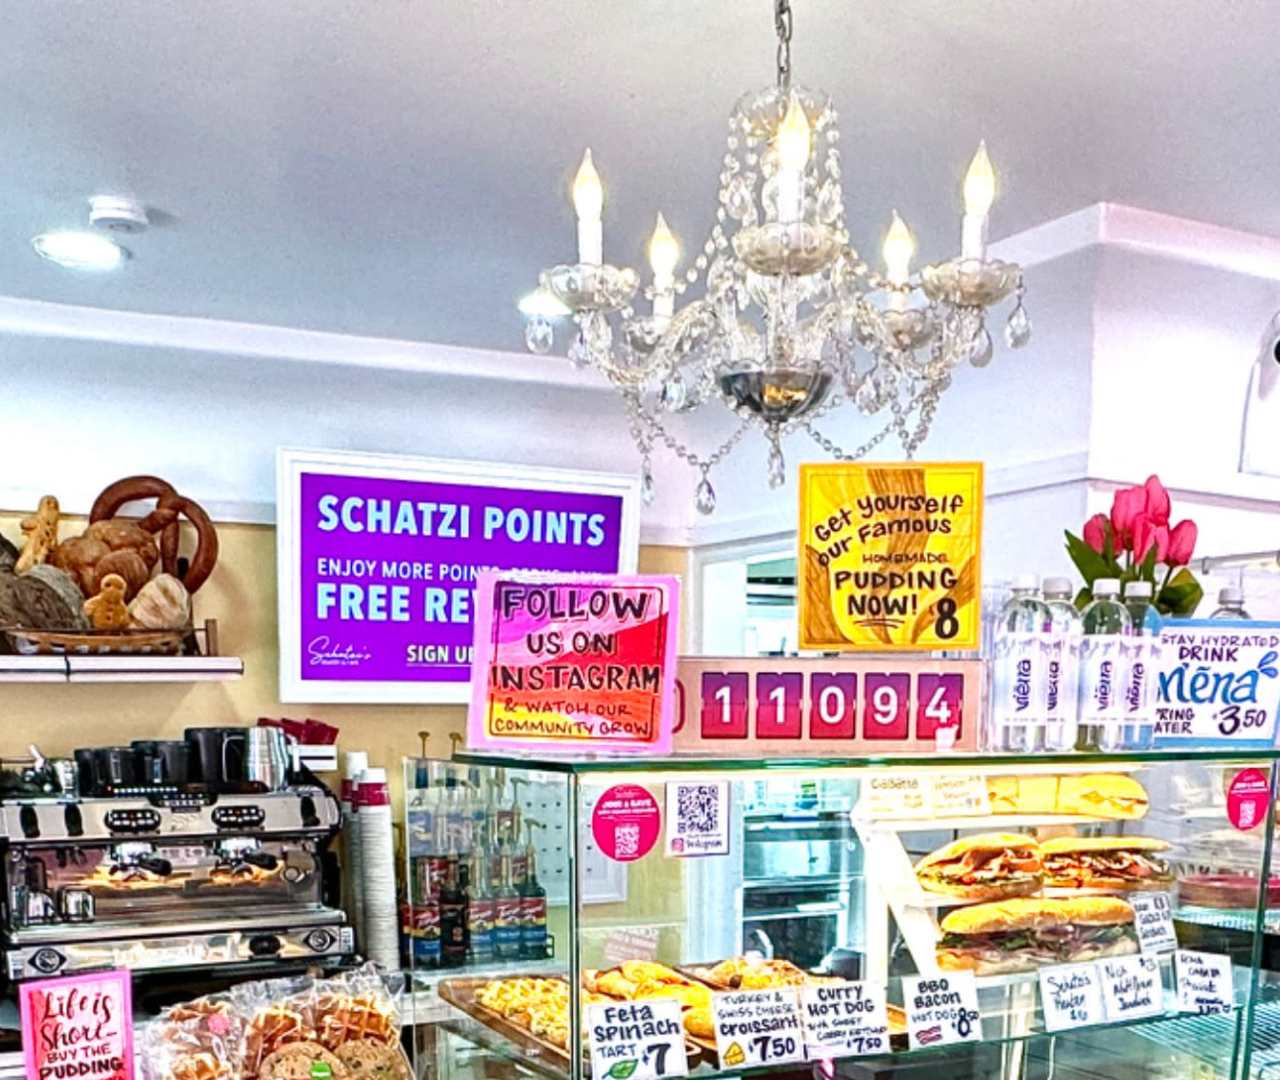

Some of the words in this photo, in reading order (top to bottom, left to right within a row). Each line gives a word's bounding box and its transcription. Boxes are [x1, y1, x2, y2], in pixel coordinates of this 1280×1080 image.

[317, 495, 471, 538] SCHATZI
[483, 506, 606, 547] POINTS
[815, 509, 852, 542] Get
[857, 494, 964, 519] yourself
[818, 538, 852, 566] our
[858, 518, 952, 544] Famous
[317, 558, 378, 578] ENJOY
[382, 562, 434, 581] MORE
[834, 569, 958, 591] PUDDING
[317, 583, 411, 622] FREE
[502, 590, 651, 622] FOLLOW
[847, 594, 918, 617] NOW!
[526, 633, 561, 655] US
[572, 631, 617, 655] ON
[1161, 634, 1195, 644] STAY
[1201, 635, 1279, 647] HYDRATED
[407, 644, 450, 663] SIGN
[1178, 646, 1239, 662] DRINK
[491, 666, 660, 693] INSTAGRAM
[502, 699, 518, 713] &
[526, 701, 589, 715] WATCH
[594, 704, 632, 716] OUR
[494, 718, 593, 736] COMMUNITY
[599, 720, 651, 736] GROW
[918, 978, 949, 993] BBQ
[93, 993, 111, 1023] is
[808, 1004, 840, 1017] HOT
[846, 999, 875, 1013] DOG
[914, 992, 961, 1009] Bacon
[604, 1005, 653, 1024] Feta
[594, 1019, 680, 1043] Spinach
[720, 1015, 798, 1036] croissant
[47, 1049, 77, 1063] BUY
[80, 1043, 111, 1057] THE
[597, 1044, 638, 1059] TART
